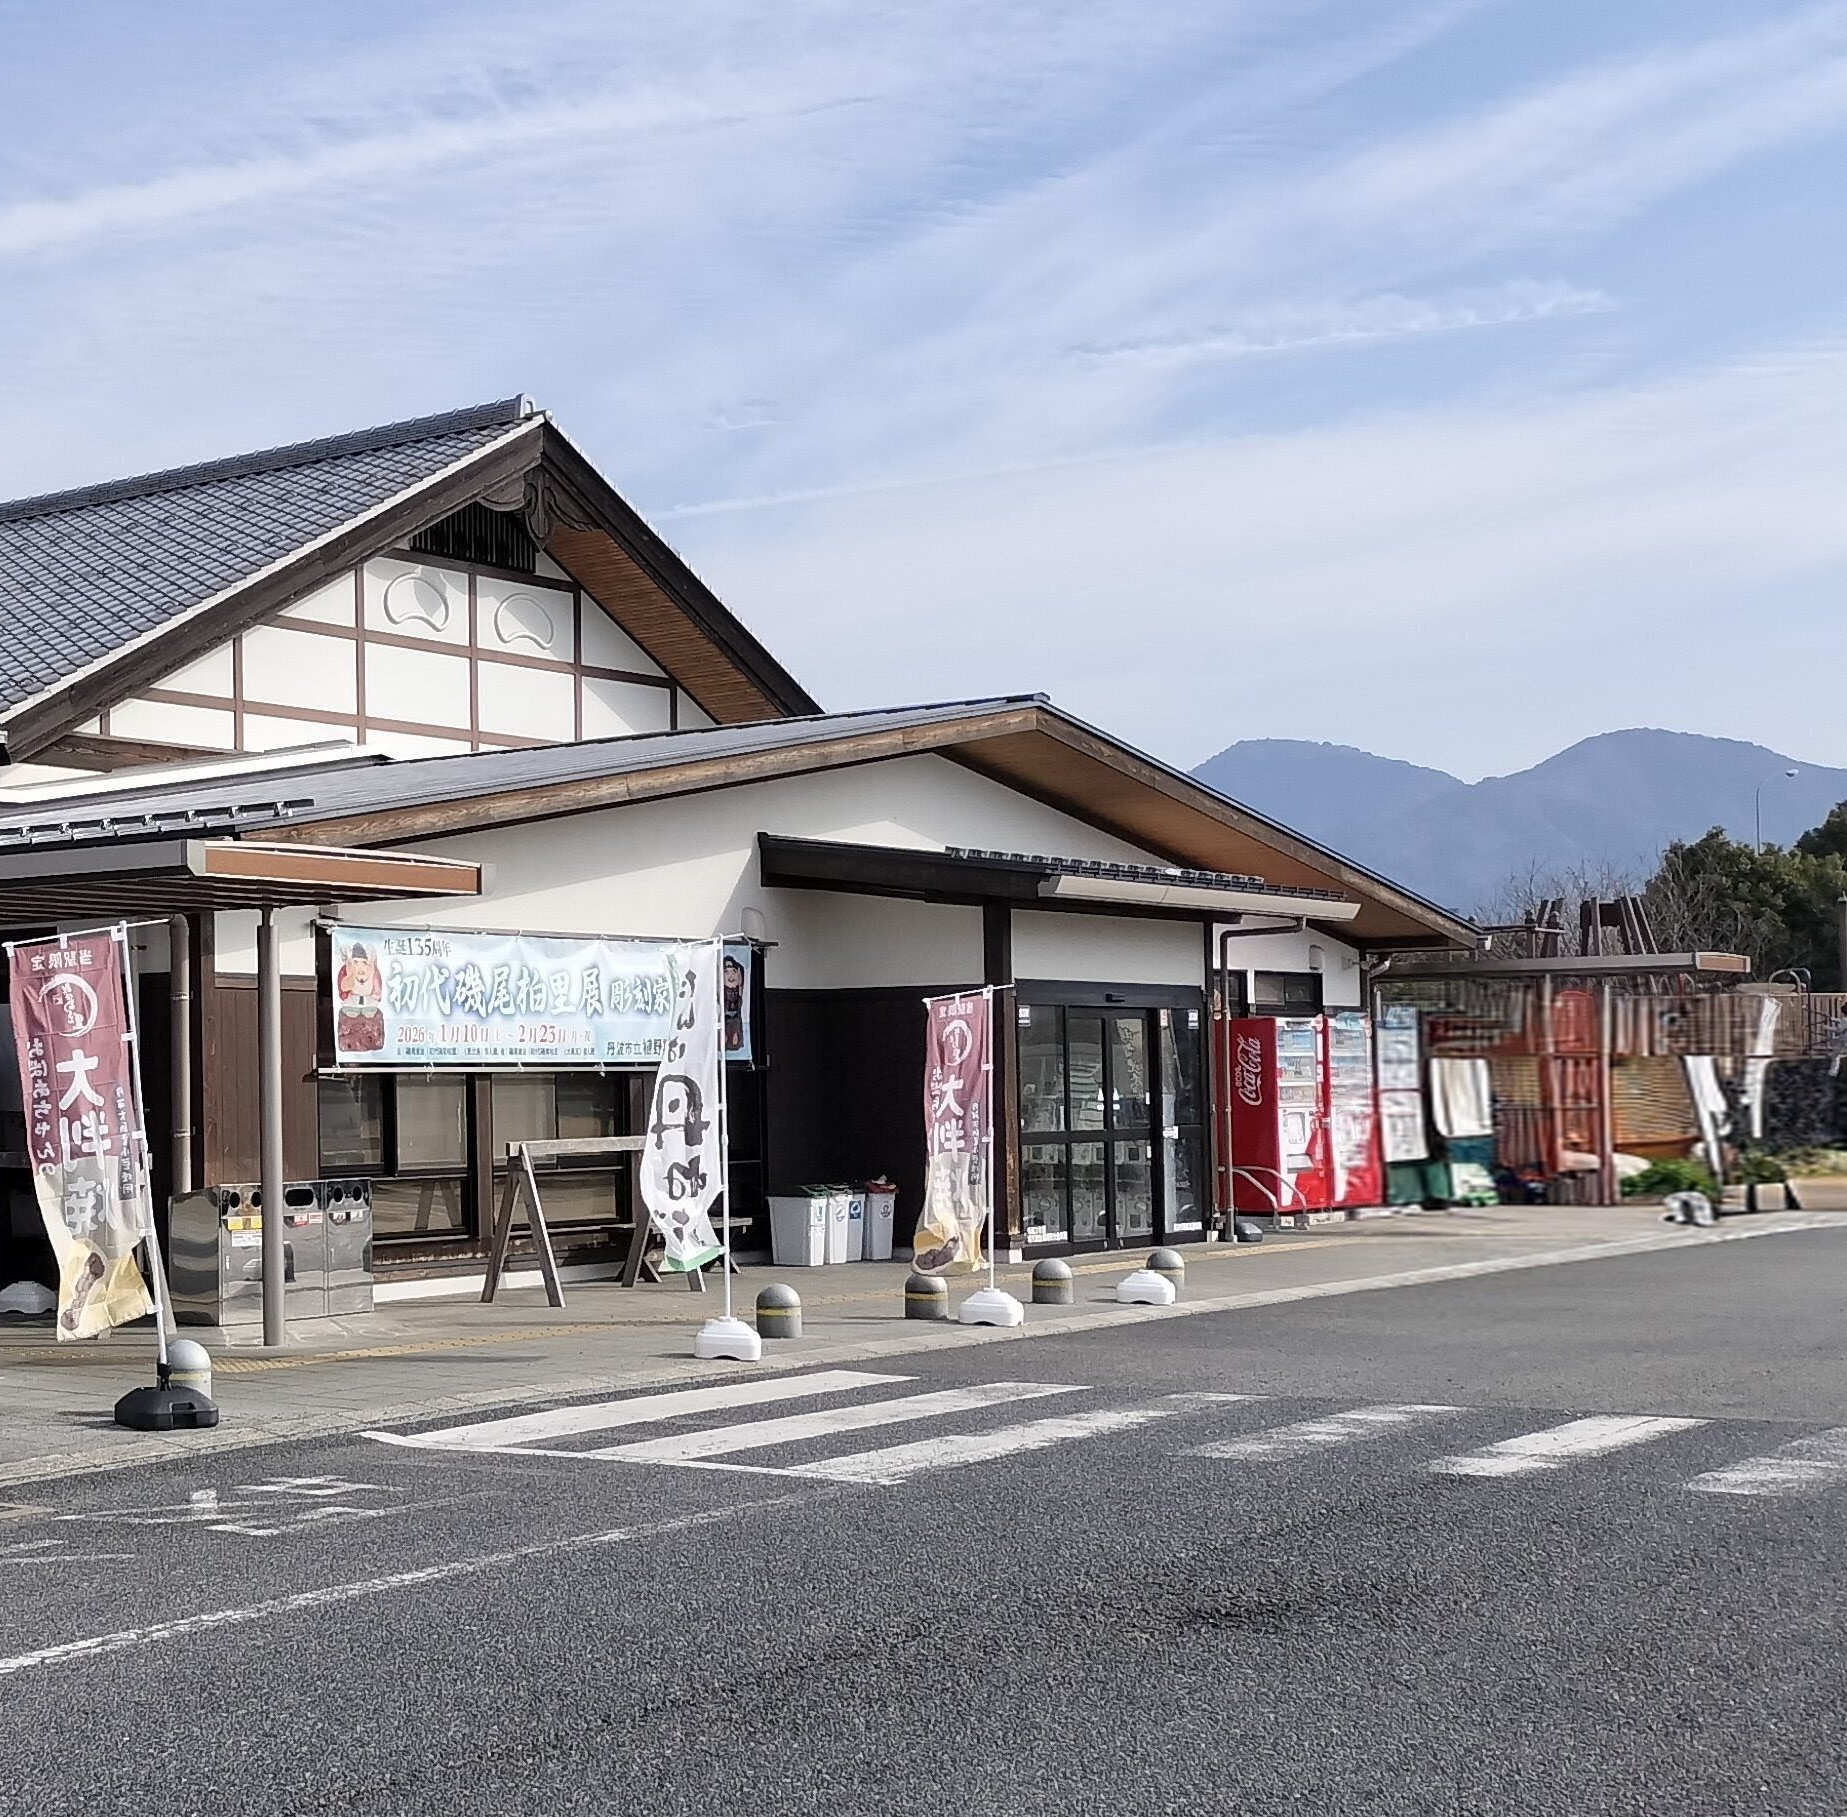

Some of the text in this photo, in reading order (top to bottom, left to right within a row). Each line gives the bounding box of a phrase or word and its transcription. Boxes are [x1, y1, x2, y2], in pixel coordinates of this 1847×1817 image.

[386, 962, 604, 1018] 初代磯尾柏里展
[1237, 1033, 1262, 1106] Coca-Cola
